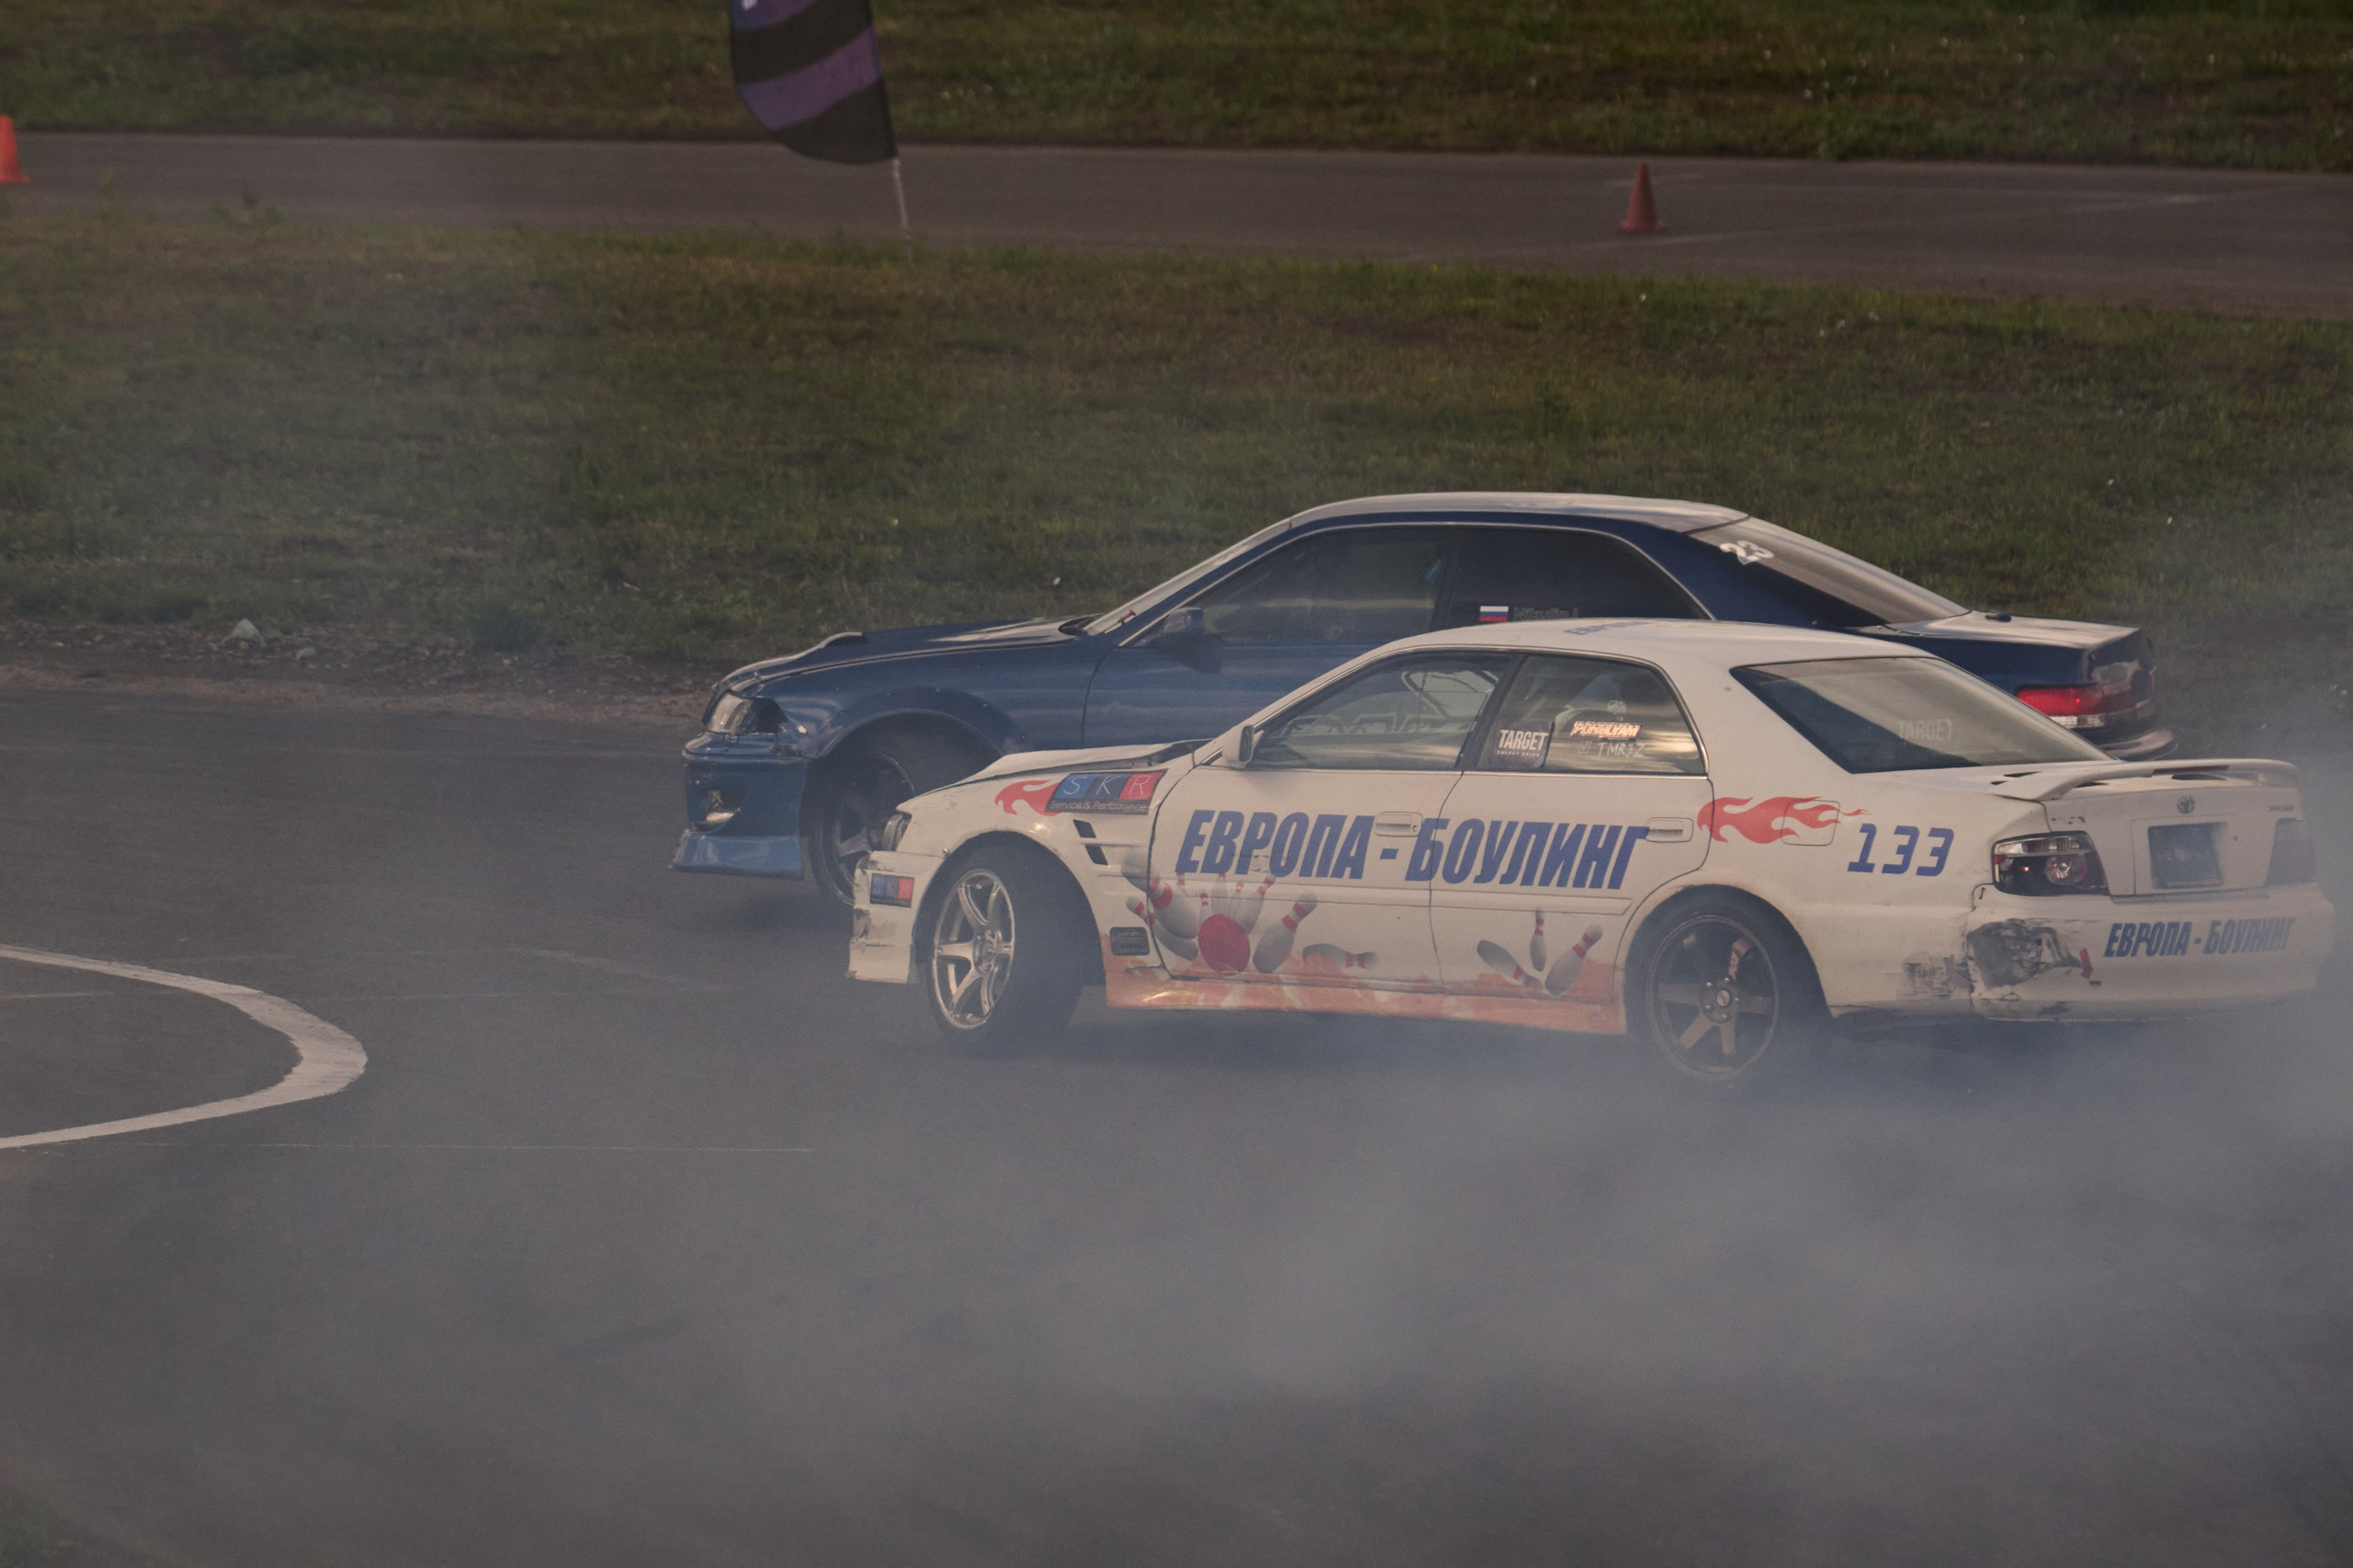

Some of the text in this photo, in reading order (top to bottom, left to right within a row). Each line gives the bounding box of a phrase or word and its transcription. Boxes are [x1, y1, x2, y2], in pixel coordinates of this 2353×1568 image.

[1719, 540, 1774, 565] 23
[1498, 729, 1549, 751] TARGET
[1896, 718, 1952, 741] TARGET
[1063, 773, 1152, 796] SKR
[1050, 800, 1082, 810] Service
[1083, 800, 1091, 810] &
[1174, 809, 1376, 880] ЕВРОПА
[1404, 817, 1651, 890] БОУЛИНГ
[1847, 823, 1955, 877] 133
[2103, 921, 2193, 958] ЕВРОПА
[2202, 915, 2297, 956] БОУЛИНГ
